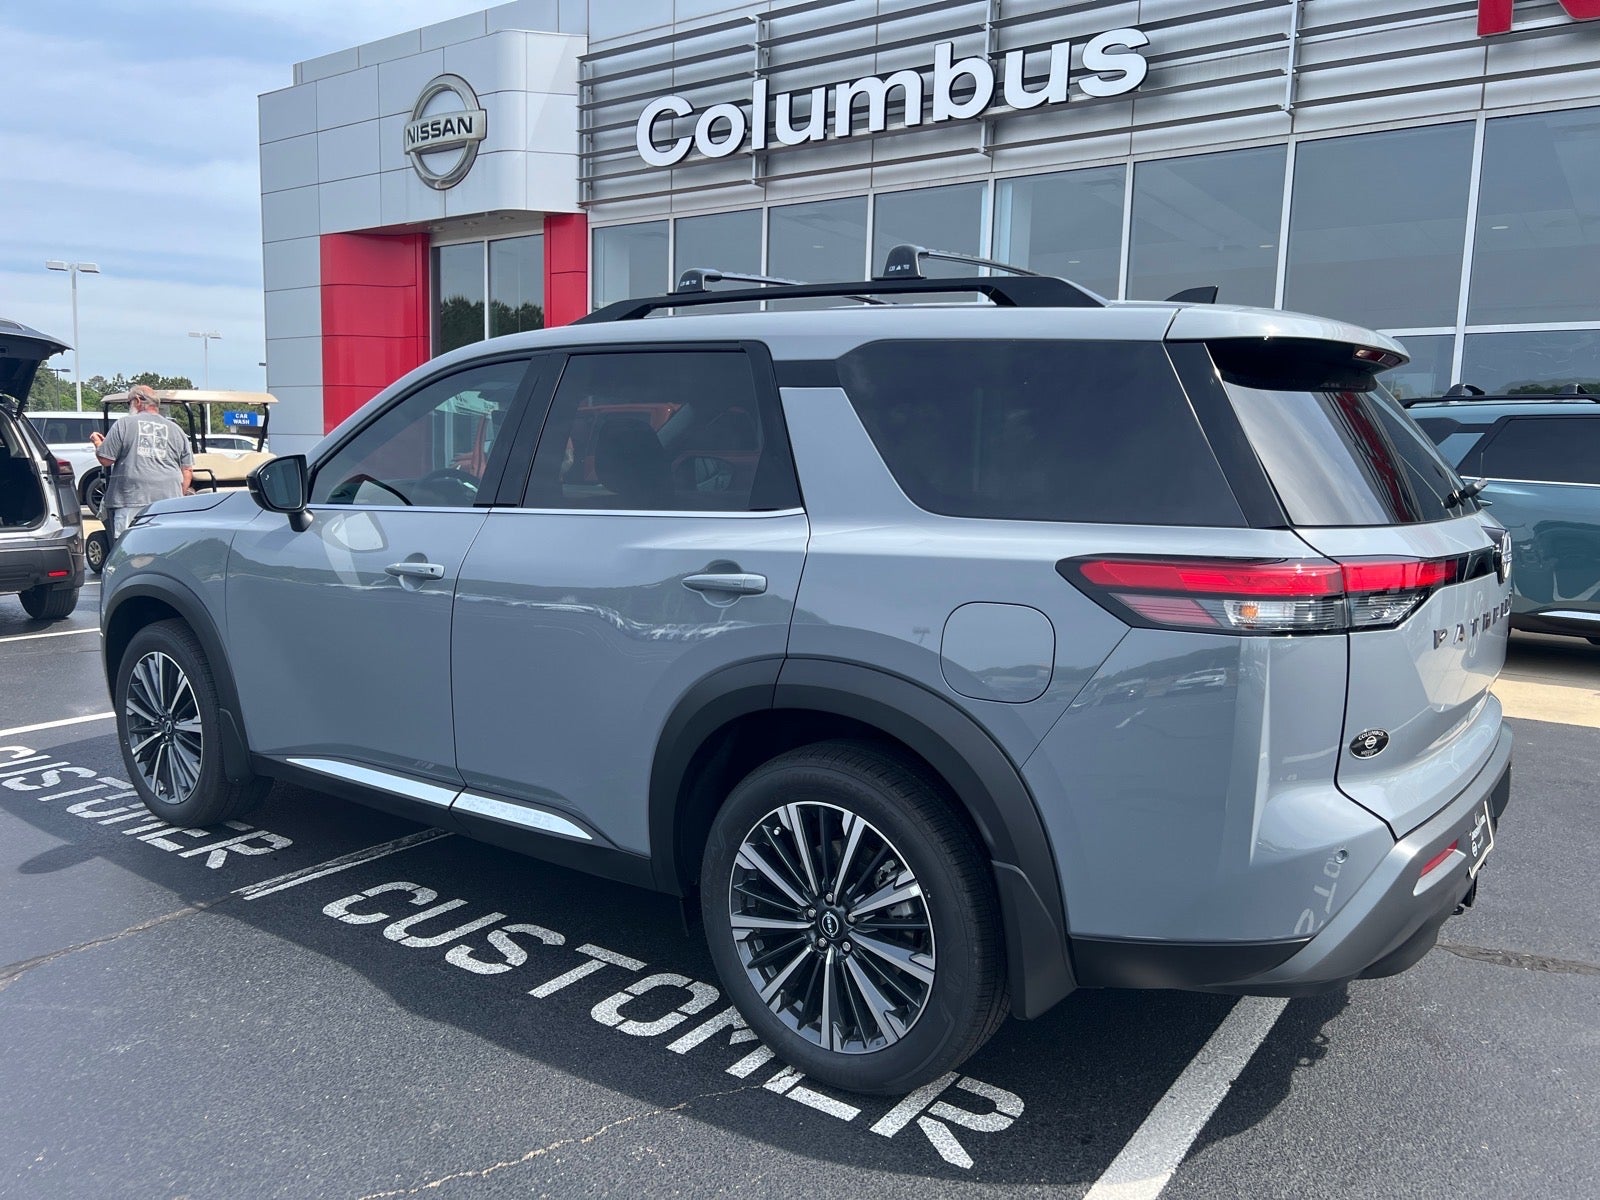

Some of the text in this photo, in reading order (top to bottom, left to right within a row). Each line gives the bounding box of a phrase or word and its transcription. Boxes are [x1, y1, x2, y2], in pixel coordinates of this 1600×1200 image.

[636, 27, 1150, 167] Columbus
[406, 116, 473, 146] NISSAN
[1358, 730, 1384, 741] COLUMBUS
